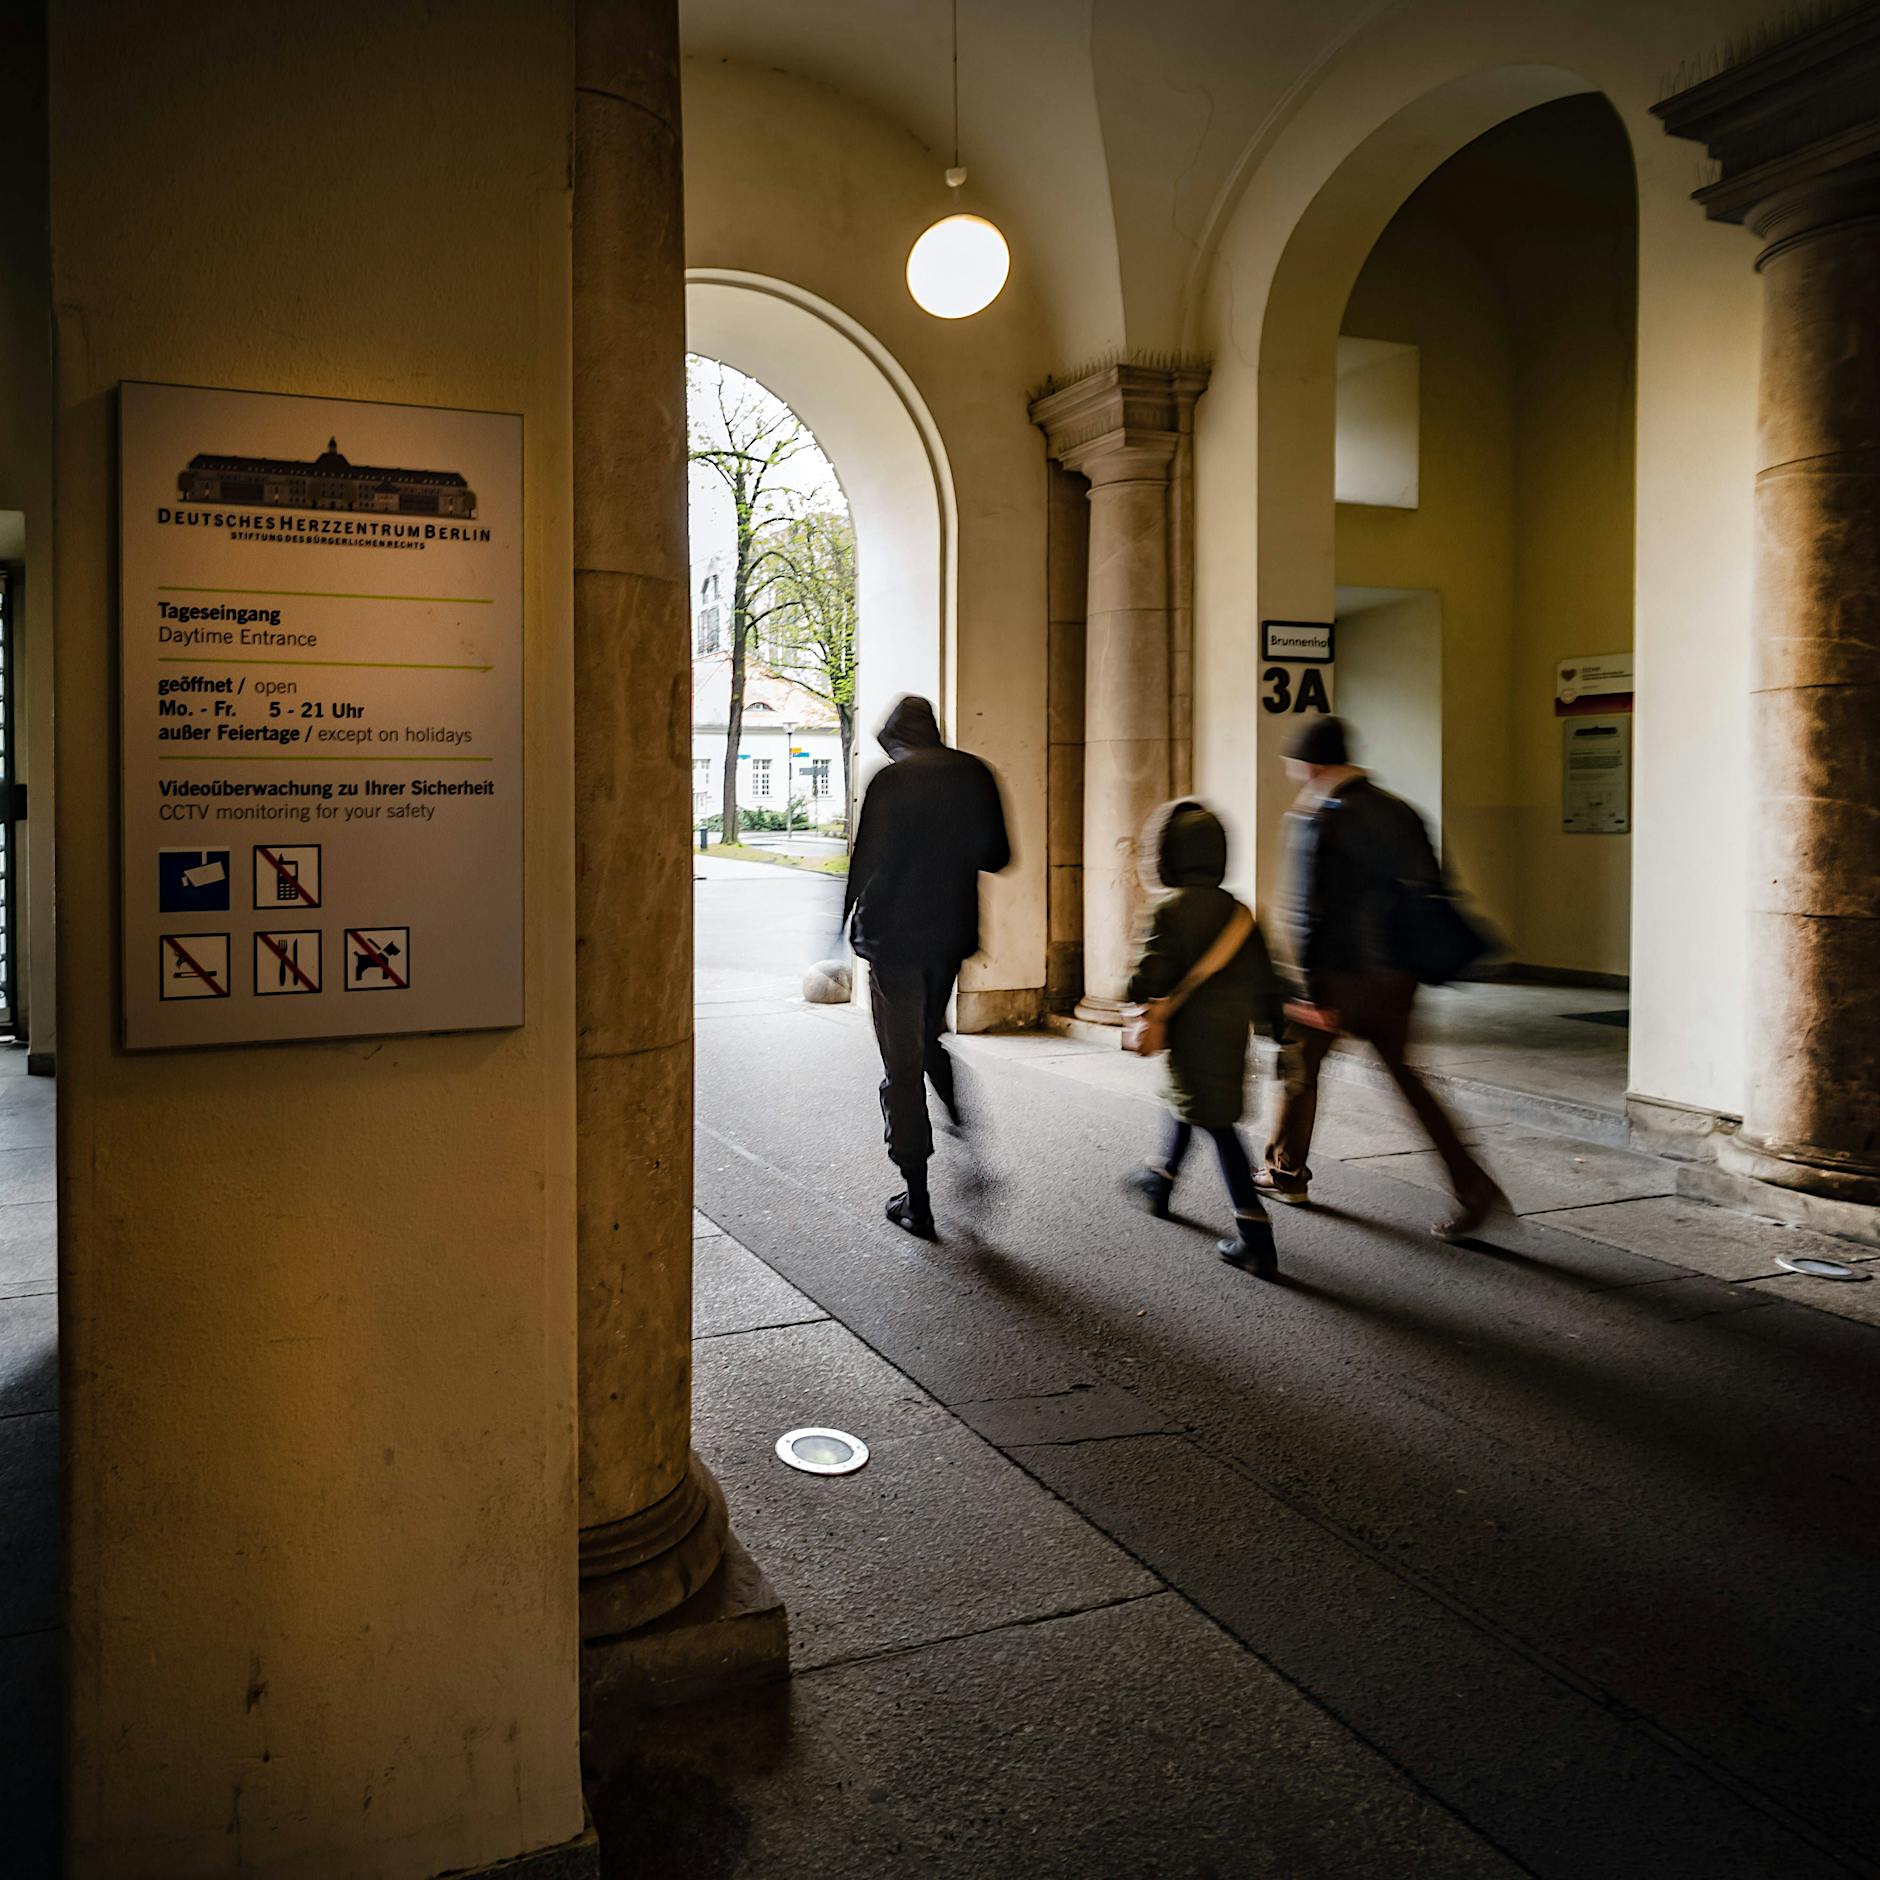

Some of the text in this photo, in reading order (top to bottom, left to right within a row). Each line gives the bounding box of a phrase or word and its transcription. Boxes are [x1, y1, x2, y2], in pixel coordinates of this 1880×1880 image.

[157, 601, 281, 625] Tageseingang
[158, 626, 318, 647] Daytime Entrance
[1271, 635, 1331, 648] Brunnenho
[157, 676, 233, 695] geöffnet
[254, 680, 298, 695] open
[1262, 666, 1331, 714] 3A
[158, 700, 194, 716] Mo.
[213, 701, 237, 718] Fr.
[268, 701, 281, 718] 5
[300, 702, 325, 719] 21
[332, 702, 365, 719] Uhr
[158, 725, 211, 742] außer
[217, 725, 301, 745] Feiertage
[318, 727, 374, 744] except
[378, 730, 399, 743] on
[405, 727, 473, 746] holidays
[158, 779, 495, 800] Videoüberwachung zu Ihrer Sicherheit
[158, 802, 436, 822] CCTV monitoring for your safety
